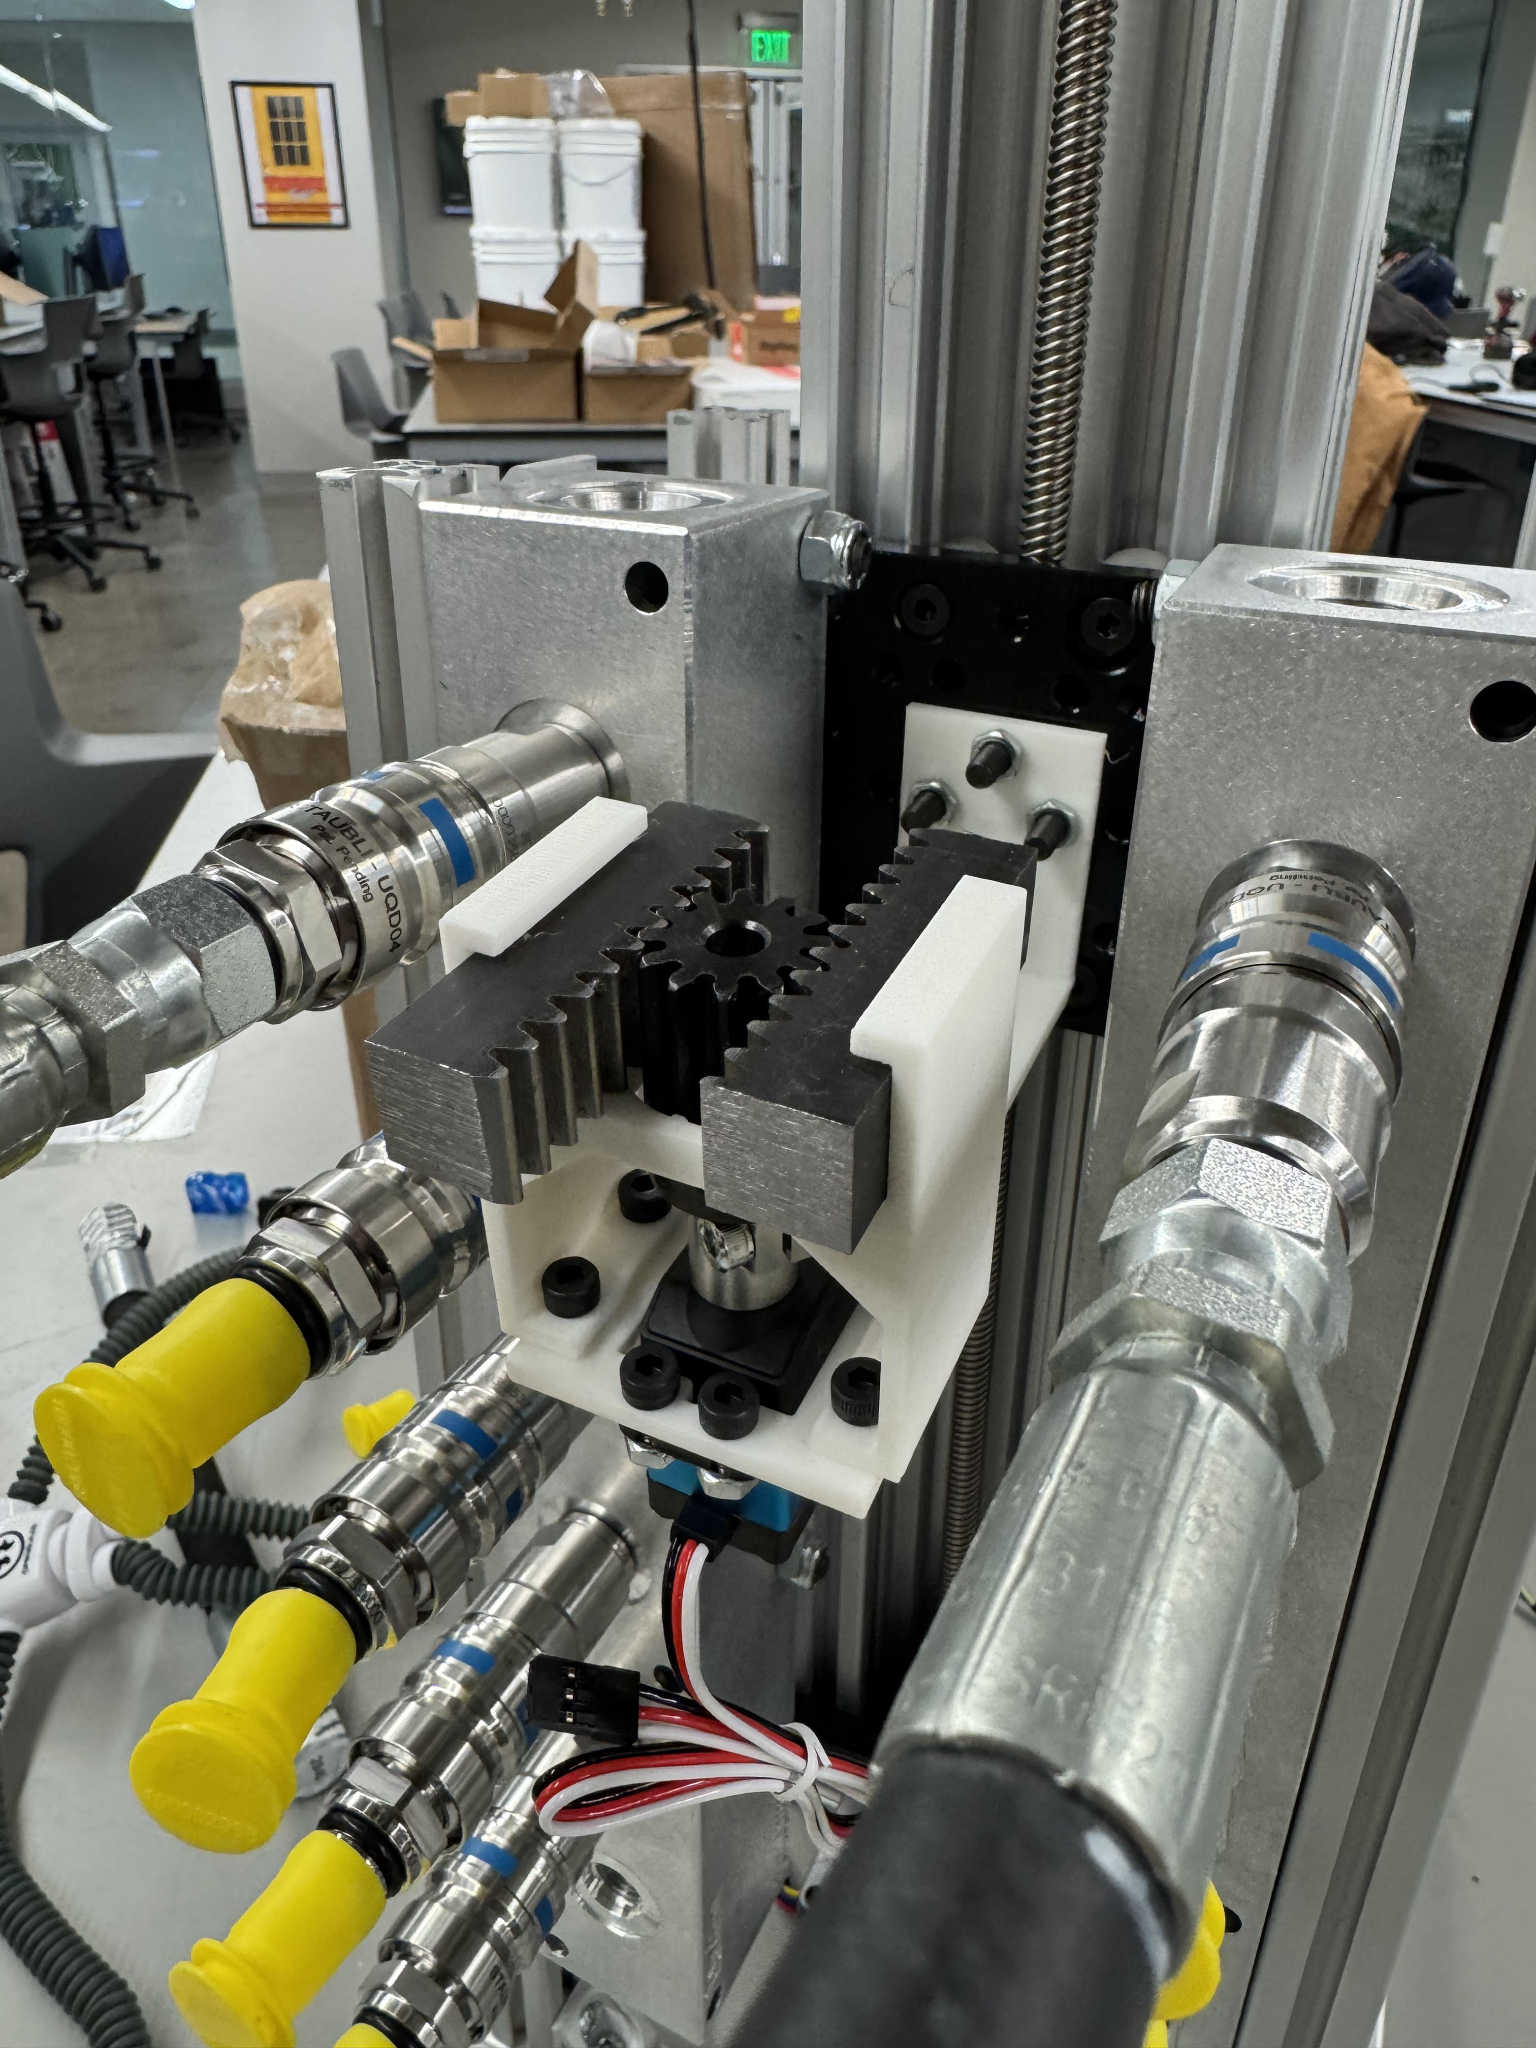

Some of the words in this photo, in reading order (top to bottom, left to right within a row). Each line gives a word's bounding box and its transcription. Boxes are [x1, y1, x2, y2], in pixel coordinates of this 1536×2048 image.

[751, 30, 790, 63] EXIT
[303, 803, 375, 859] TAUBLI
[377, 873, 403, 953] UQD04
